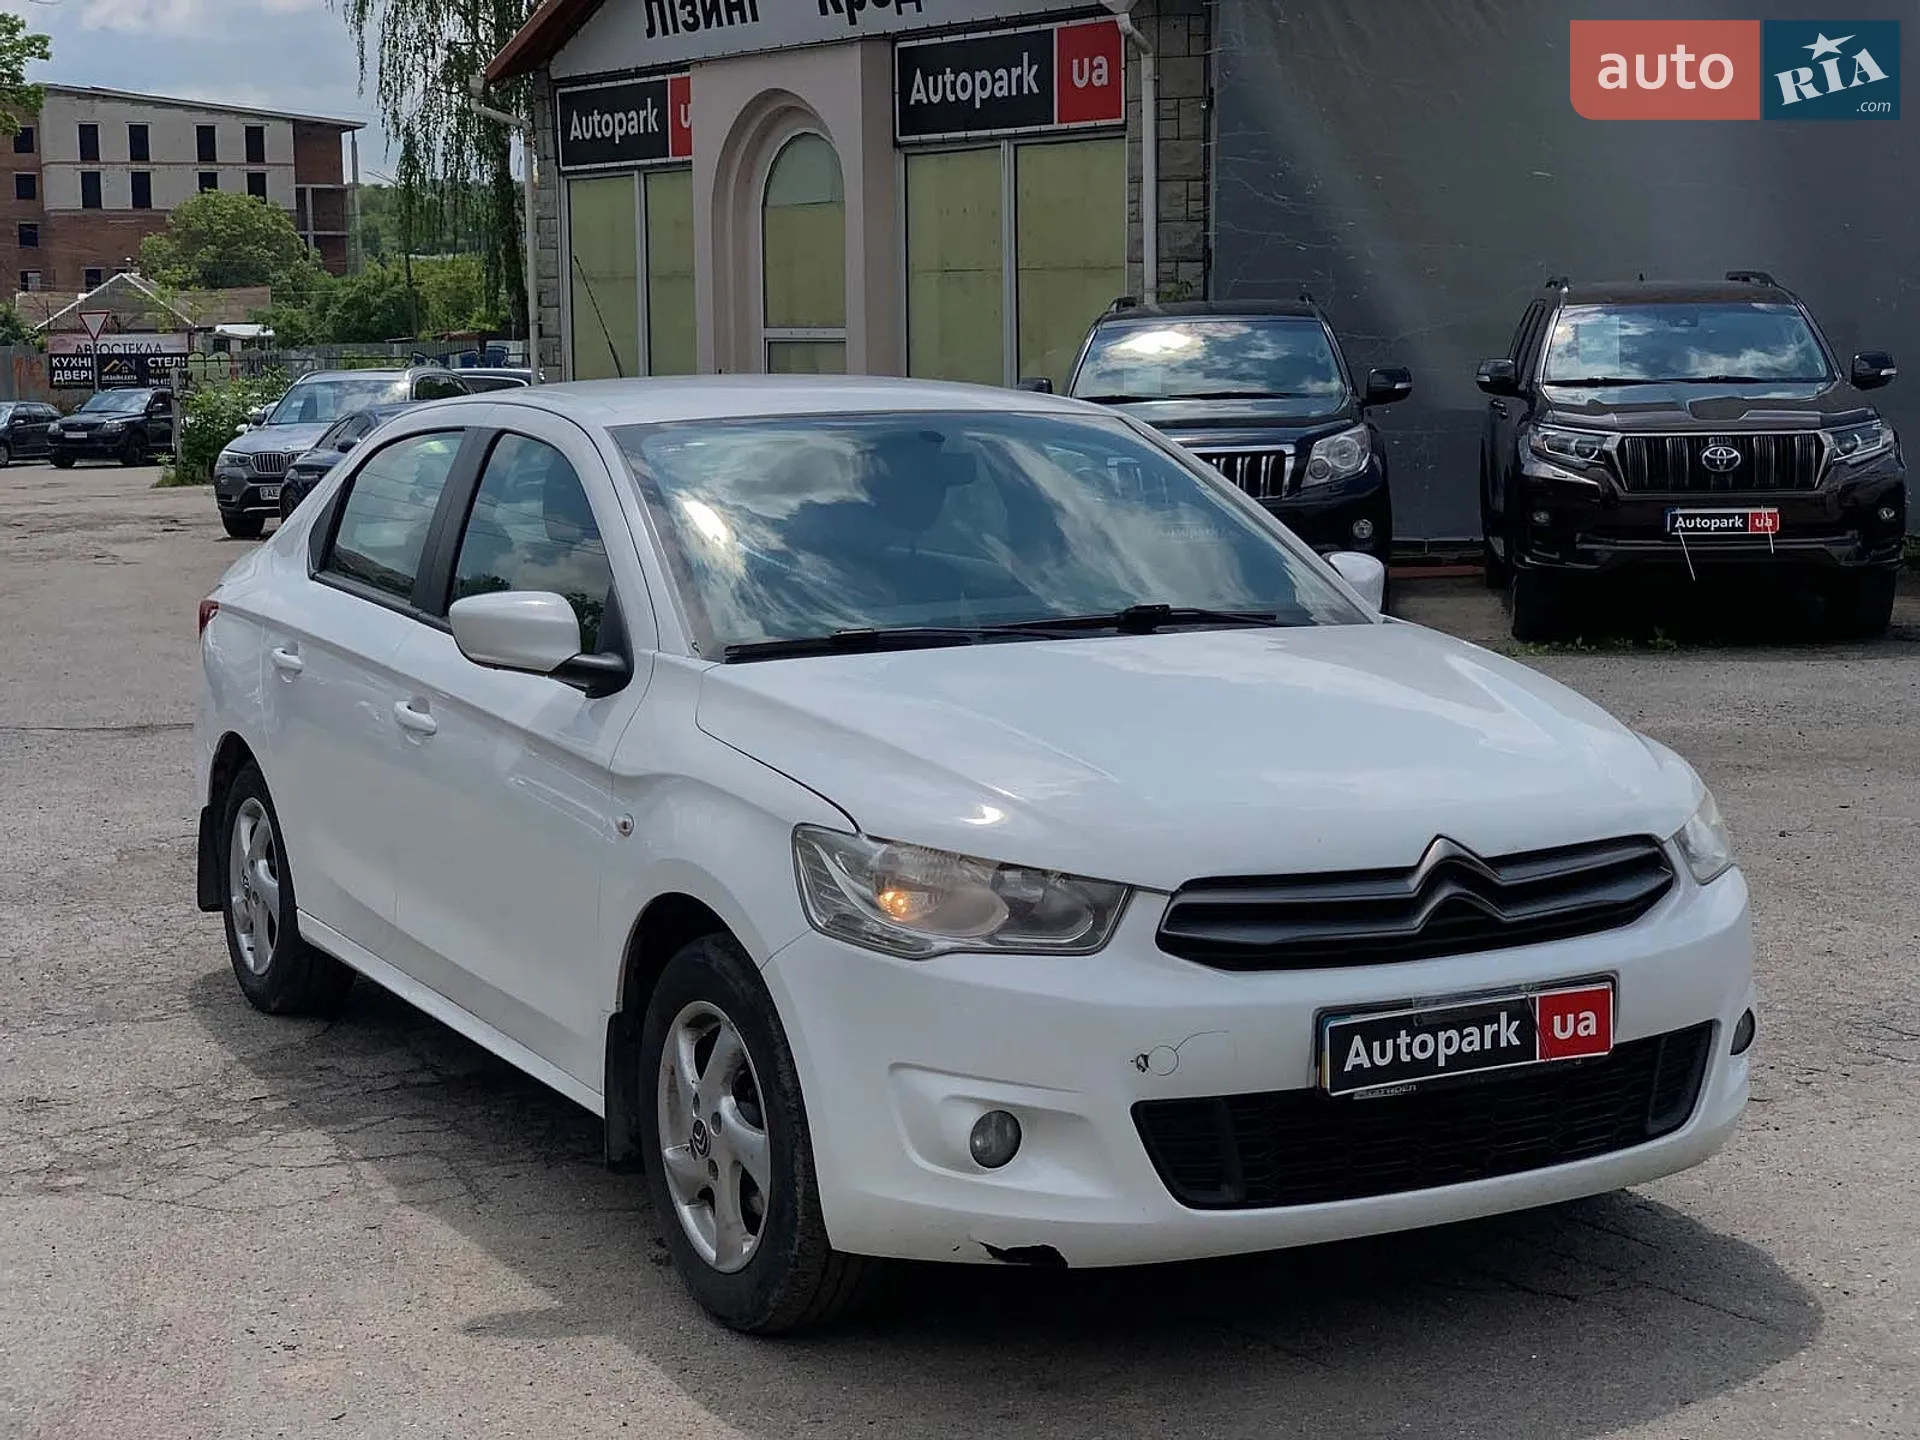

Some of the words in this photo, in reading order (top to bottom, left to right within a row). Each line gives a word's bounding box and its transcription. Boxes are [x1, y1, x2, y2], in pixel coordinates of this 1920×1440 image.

[909, 51, 1040, 109] Autopark
[1072, 55, 1109, 89] ua
[569, 97, 659, 145] Autopark
[680, 103, 691, 129] u
[52, 357, 92, 367] КУХНІ
[54, 370, 92, 382] ДВЕРІ
[1675, 515, 1744, 531] Autopark
[1755, 518, 1773, 527] ua
[1343, 1011, 1521, 1072] Autopark
[1553, 1010, 1597, 1039] ua
